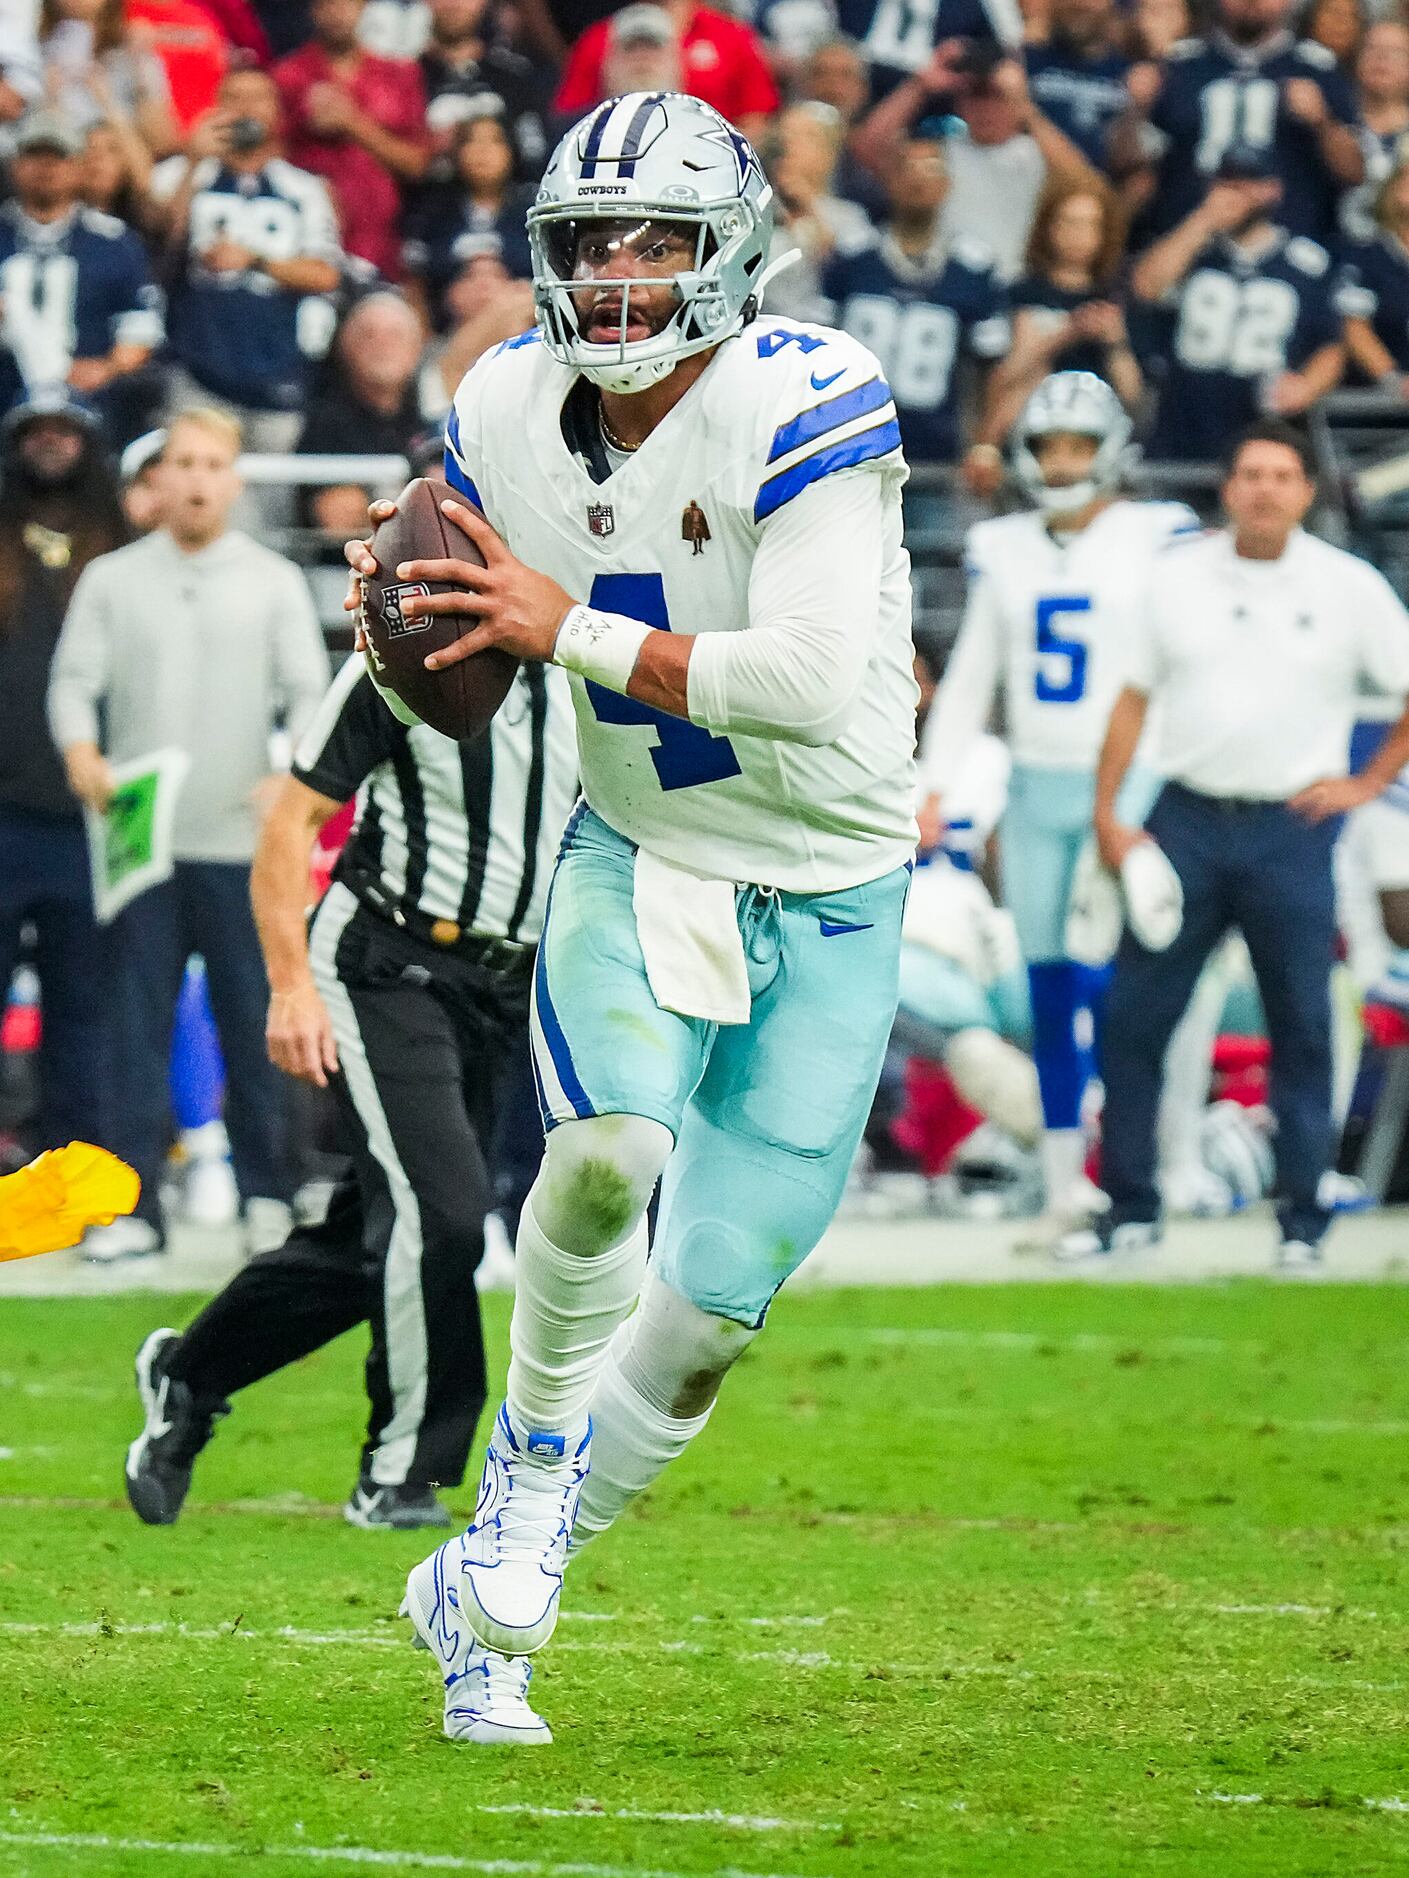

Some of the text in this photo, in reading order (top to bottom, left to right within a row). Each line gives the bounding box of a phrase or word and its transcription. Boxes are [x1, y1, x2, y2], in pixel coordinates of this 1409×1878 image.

[577, 184, 628, 196] COWBOYS
[757, 328, 829, 359] 4
[591, 515, 612, 534] NFL
[400, 585, 426, 630] NL
[1035, 594, 1092, 703] 5
[584, 572, 743, 792] 4
